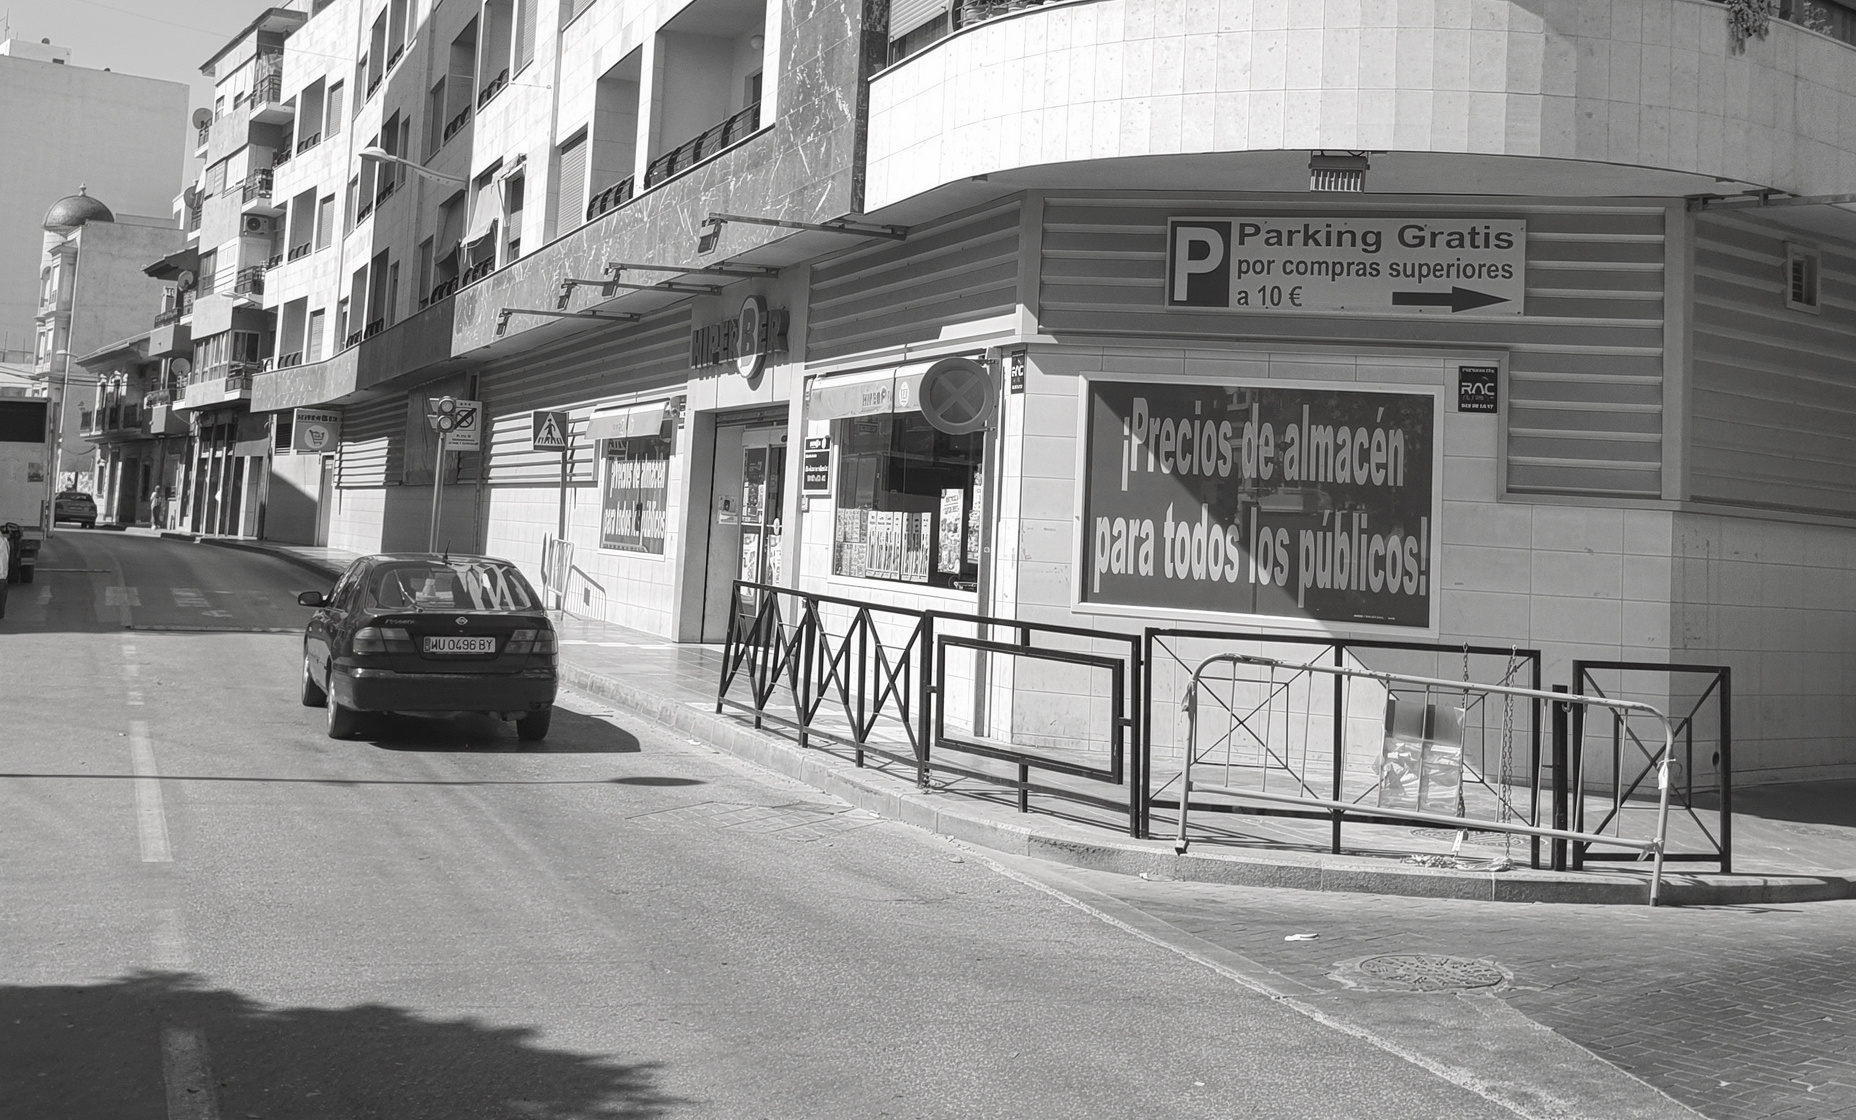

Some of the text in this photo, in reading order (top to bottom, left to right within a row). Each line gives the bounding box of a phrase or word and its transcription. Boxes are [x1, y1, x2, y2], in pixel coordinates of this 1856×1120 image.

[1237, 222, 1515, 254] Parking Gratis
[1174, 226, 1225, 302] P
[1237, 257, 1514, 284] por compras superiores
[1237, 285, 1303, 307] a 10 €
[691, 306, 790, 370] HIPERBER
[1461, 382, 1495, 396] RAC
[1121, 397, 1404, 492] ¡Precios de almacén
[1094, 500, 1428, 609] para todos los públicos!
[448, 639, 477, 651] 0496
[479, 639, 493, 651] BY
